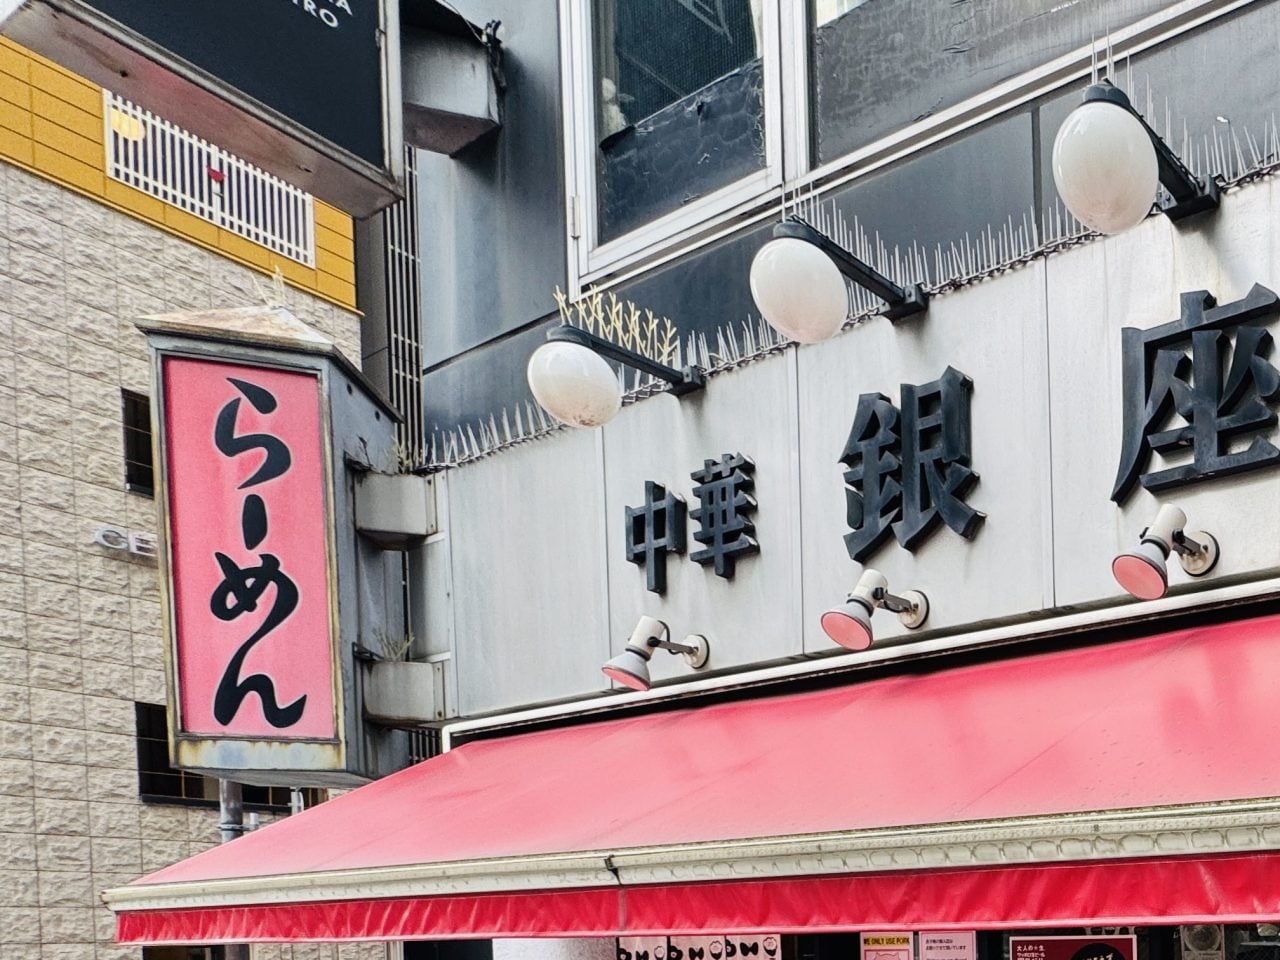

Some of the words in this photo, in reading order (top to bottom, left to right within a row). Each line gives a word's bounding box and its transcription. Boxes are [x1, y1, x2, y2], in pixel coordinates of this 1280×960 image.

[210, 377, 307, 729] らーめん
[624, 452, 759, 594] 中華
